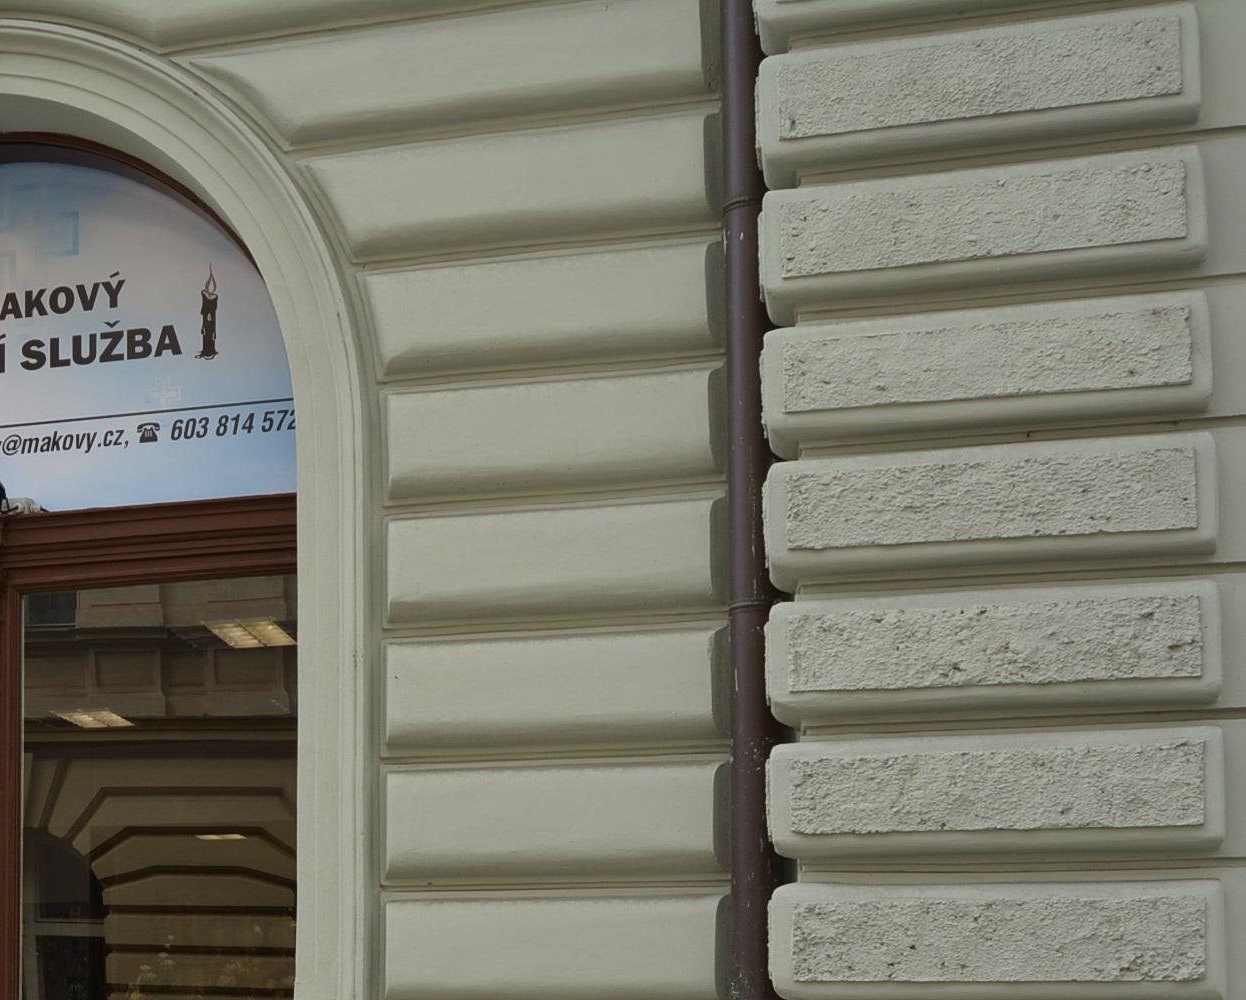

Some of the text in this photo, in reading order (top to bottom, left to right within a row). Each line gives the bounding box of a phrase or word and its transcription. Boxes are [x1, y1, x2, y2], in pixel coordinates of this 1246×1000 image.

[20, 321, 183, 373] SLUŽBA
[170, 416, 210, 441] 603
[215, 412, 255, 437] 814
